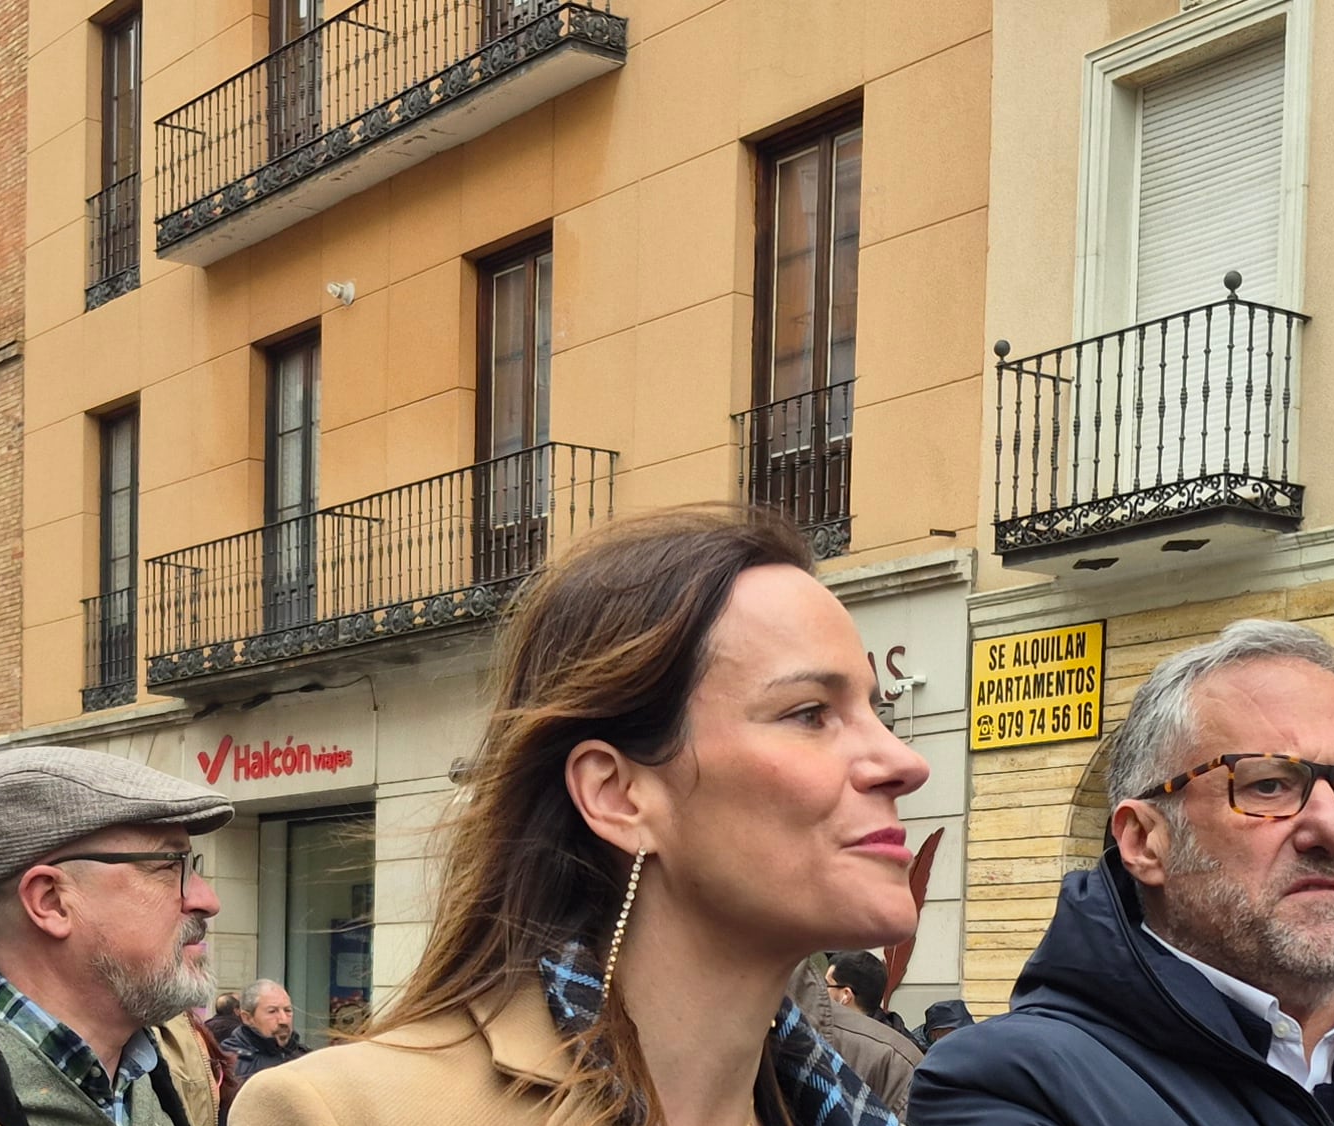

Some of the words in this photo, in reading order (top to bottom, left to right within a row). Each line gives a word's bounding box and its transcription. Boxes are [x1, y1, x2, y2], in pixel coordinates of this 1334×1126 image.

[988, 644, 1006, 671] SE
[1012, 631, 1087, 670] ALQUILAN
[976, 665, 1096, 707] APARTAMENTOS
[997, 709, 1024, 740] 979
[1028, 707, 1046, 736] 74
[1051, 703, 1072, 733] 56
[1076, 701, 1094, 730] 16
[233, 735, 312, 782] Halcón
[312, 744, 353, 774] viajes
